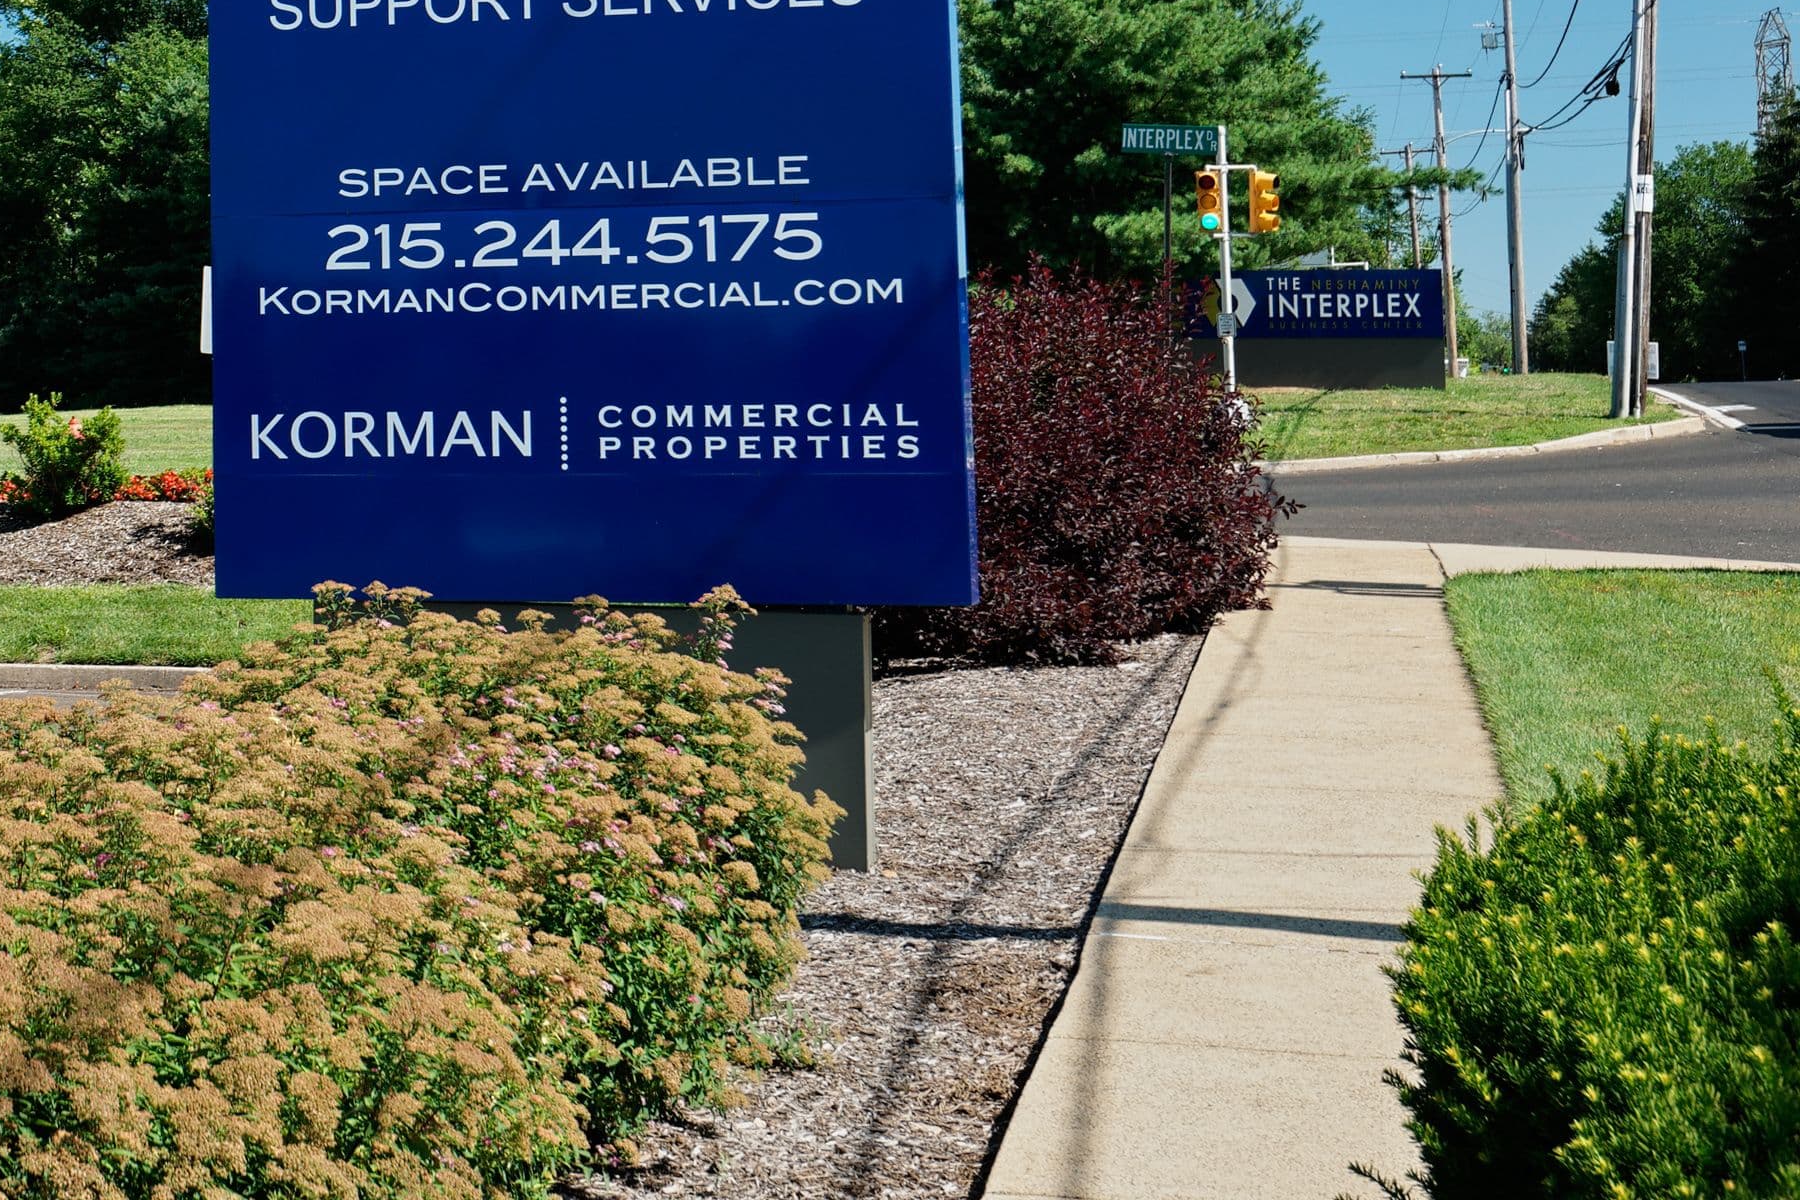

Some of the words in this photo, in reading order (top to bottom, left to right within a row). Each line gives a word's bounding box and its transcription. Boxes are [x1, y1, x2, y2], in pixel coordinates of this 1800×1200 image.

[1121, 127, 1205, 151] INTERPLEX
[338, 164, 509, 198] SPACE
[521, 155, 810, 193] AVAILABLE
[325, 212, 823, 271] 215.244.5175
[1266, 276, 1301, 291] THE
[1311, 278, 1421, 291] NESHAMINY
[1267, 292, 1422, 318] INTERPLEX
[598, 403, 919, 428] COMMERCIAL
[251, 410, 532, 460] KORMAN
[599, 435, 920, 459] PROPERTIES
